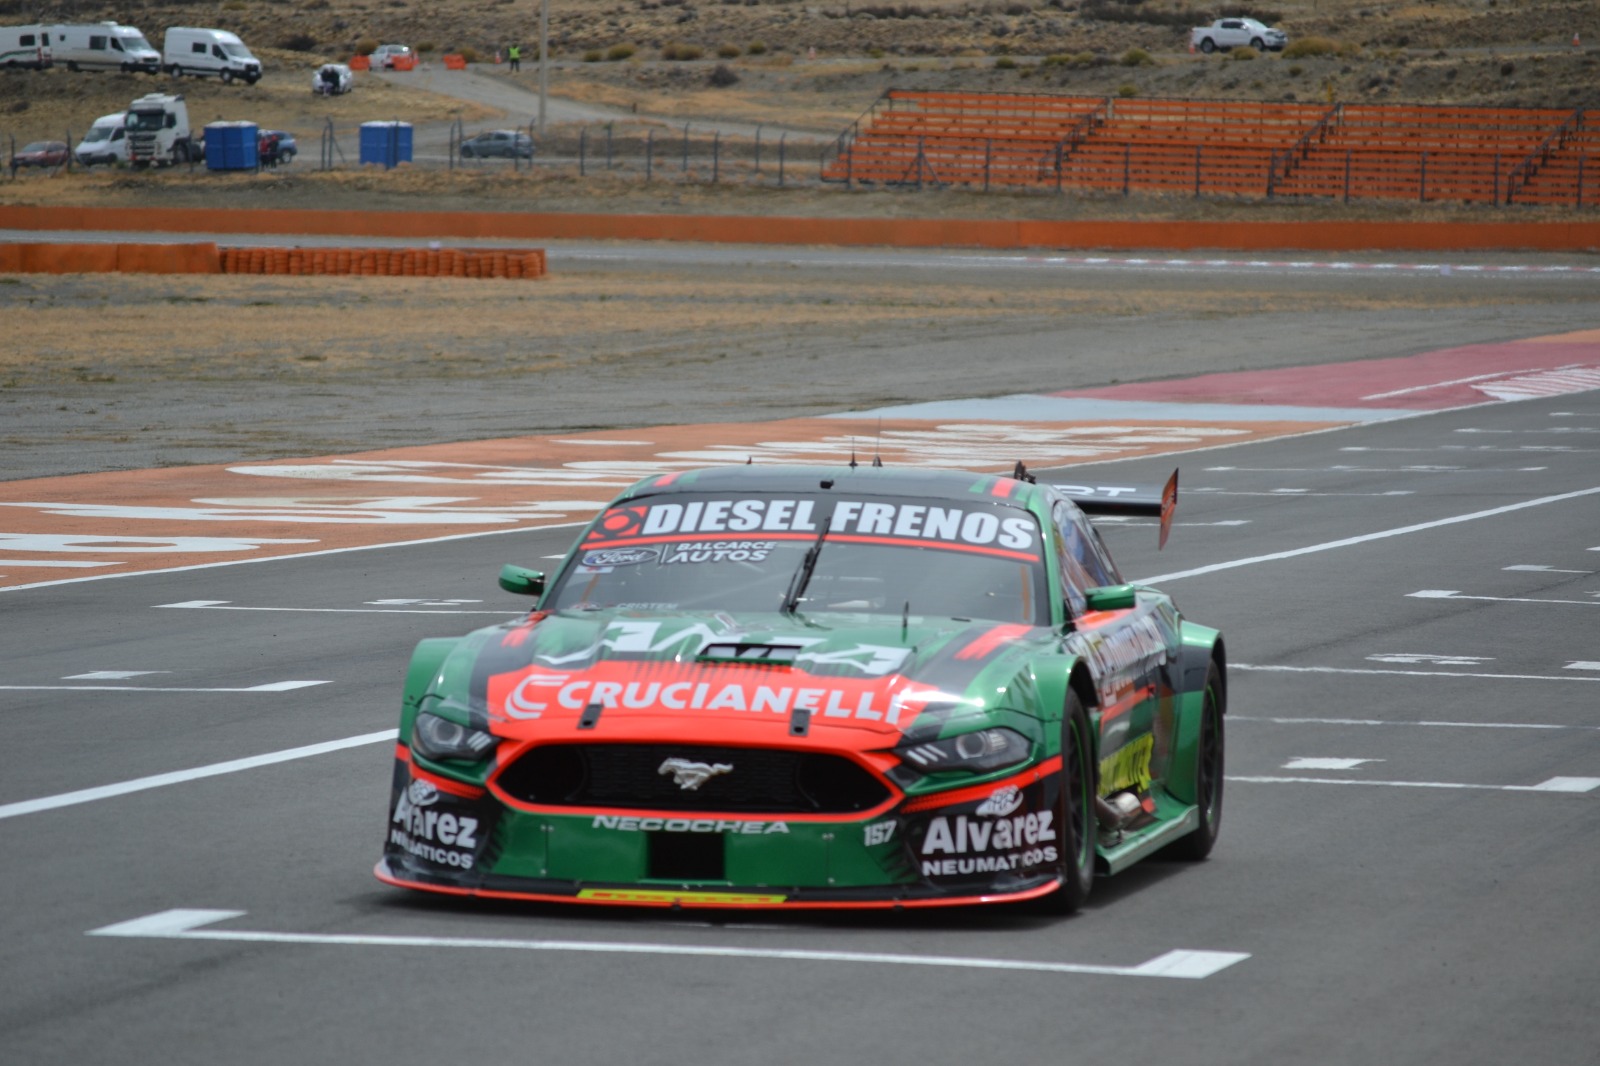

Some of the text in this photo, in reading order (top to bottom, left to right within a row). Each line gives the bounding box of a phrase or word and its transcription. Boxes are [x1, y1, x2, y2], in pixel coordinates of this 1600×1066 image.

[642, 499, 1035, 549] DIESEL FRENOS
[666, 549, 769, 563] AUTOS
[676, 541, 777, 551] BALCARCE
[557, 680, 902, 725] CRUCIANELLI
[592, 814, 790, 835] NECOCHEA
[864, 820, 897, 846] 157
[921, 810, 1056, 855] Alvarez
